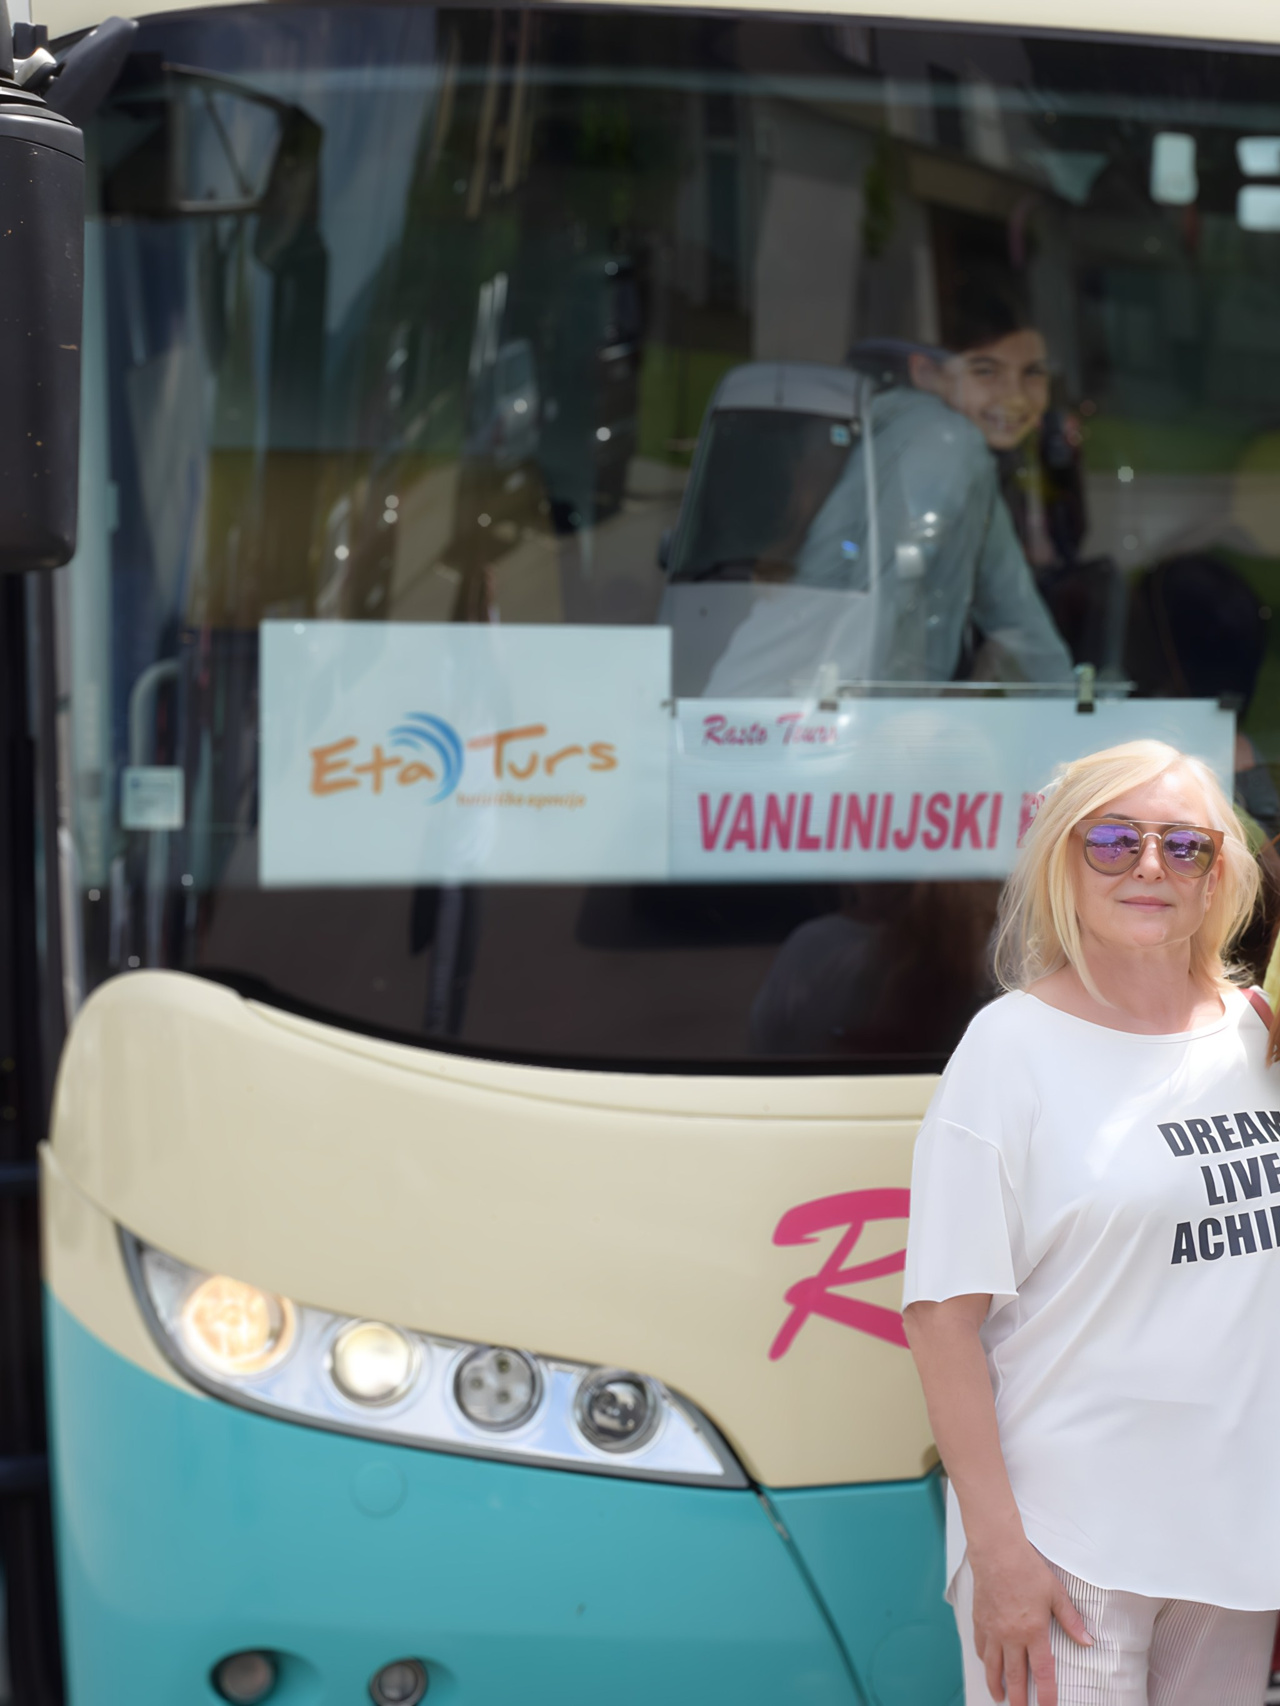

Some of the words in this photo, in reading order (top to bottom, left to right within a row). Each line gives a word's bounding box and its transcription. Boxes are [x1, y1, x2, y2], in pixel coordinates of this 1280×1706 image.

[309, 736, 436, 796] Eta
[467, 724, 619, 780] Turs
[699, 792, 1003, 851] VANLINIJSKI
